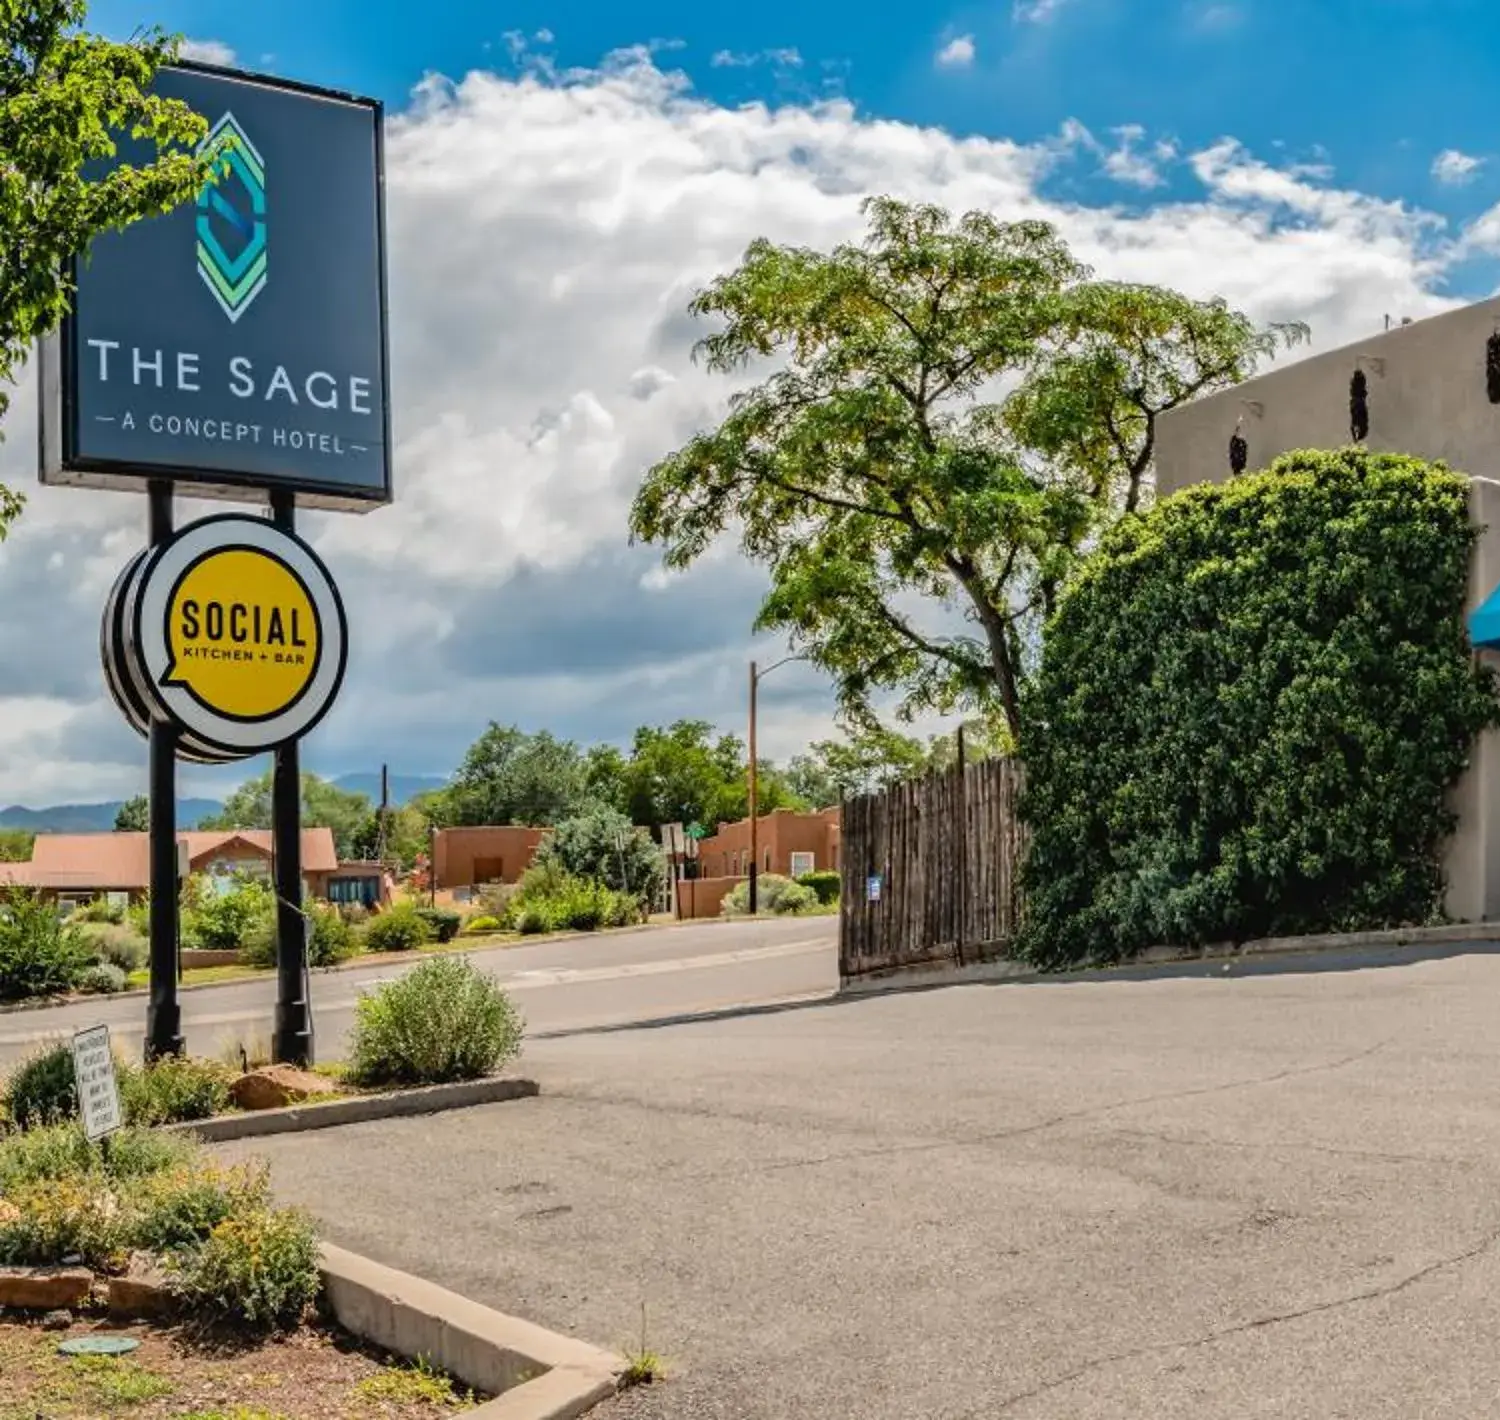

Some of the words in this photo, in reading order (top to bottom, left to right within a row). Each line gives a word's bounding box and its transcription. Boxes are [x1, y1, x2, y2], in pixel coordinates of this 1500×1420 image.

[88, 339, 200, 391] THE
[228, 357, 371, 414] SAGE
[122, 412, 135, 430] A
[149, 415, 262, 443] CONCEPT
[273, 428, 344, 454] HOTEL
[182, 600, 306, 646] SOCIAL
[183, 647, 253, 661] KITCHEN
[274, 653, 305, 665] BAR
